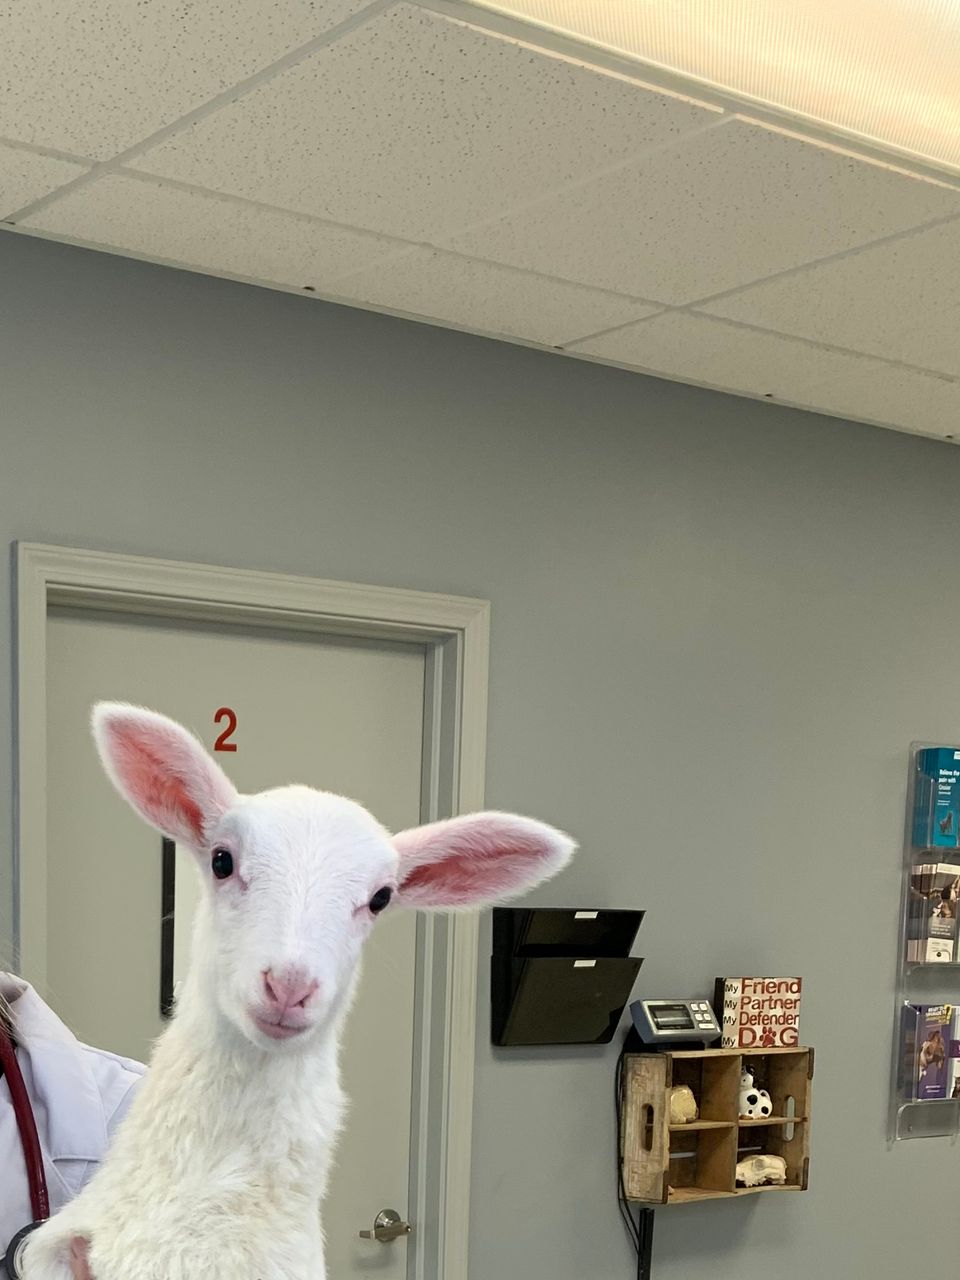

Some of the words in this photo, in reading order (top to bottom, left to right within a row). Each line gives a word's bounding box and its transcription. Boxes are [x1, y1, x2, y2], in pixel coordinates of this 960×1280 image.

[213, 707, 238, 752] 2
[725, 984, 738, 993] My
[741, 977, 801, 994] Friend
[725, 1000, 737, 1009] My
[740, 995, 801, 1010] Partner
[724, 1016, 737, 1025] My
[739, 1011, 800, 1026] Defender
[723, 1037, 735, 1046] My
[738, 1026, 799, 1048] DG
